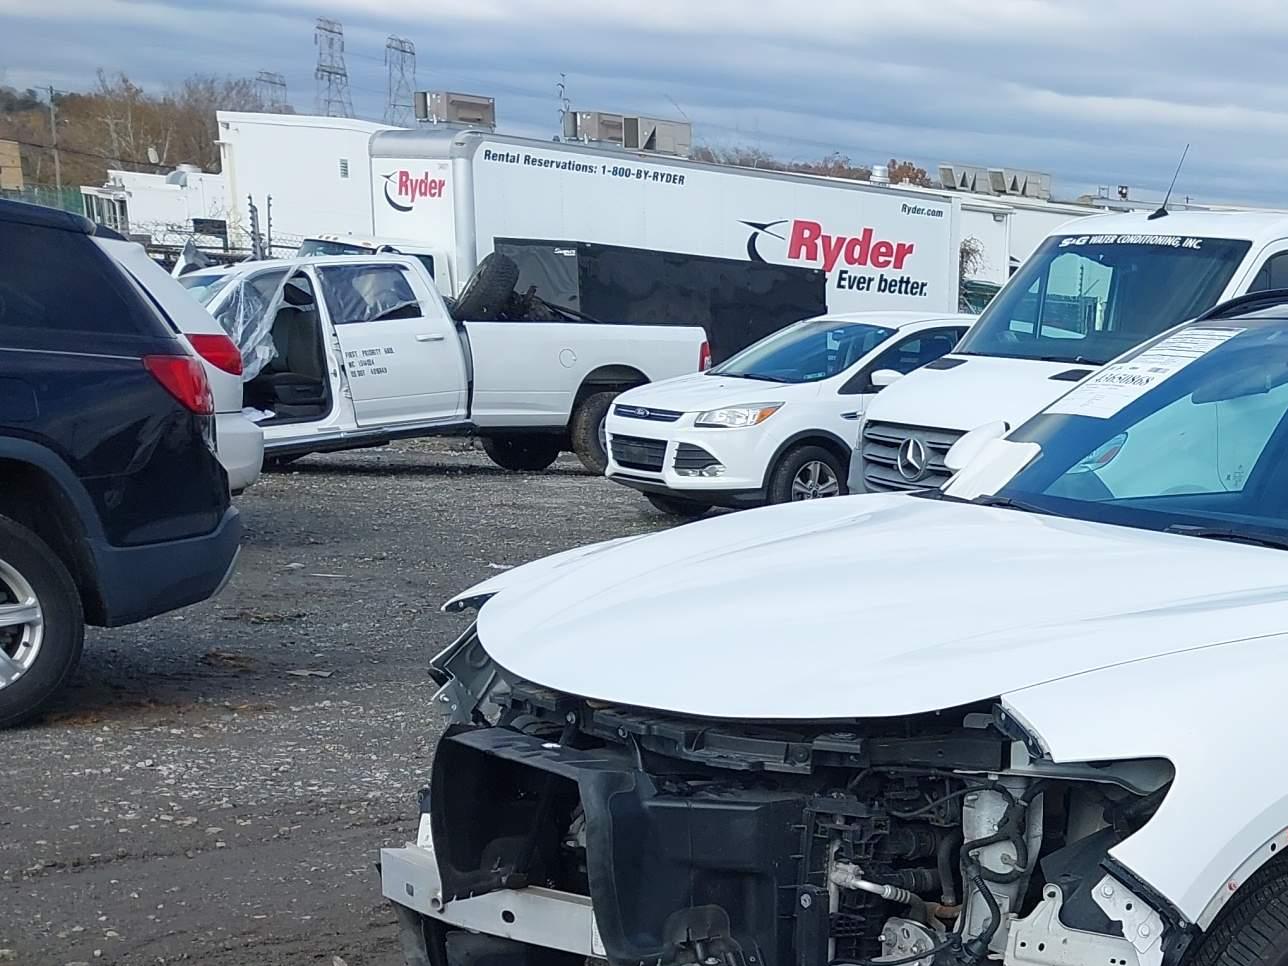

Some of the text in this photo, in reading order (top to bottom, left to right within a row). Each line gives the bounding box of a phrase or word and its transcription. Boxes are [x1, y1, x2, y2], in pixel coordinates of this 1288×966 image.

[483, 149, 686, 186] Rental Reservations: 1-800-BY-RYDER
[398, 170, 446, 203] Ryder
[901, 203, 944, 218] Ryder.com
[787, 219, 915, 273] Ryder
[1089, 235, 1115, 245] WATER
[836, 269, 928, 297] Ever better.
